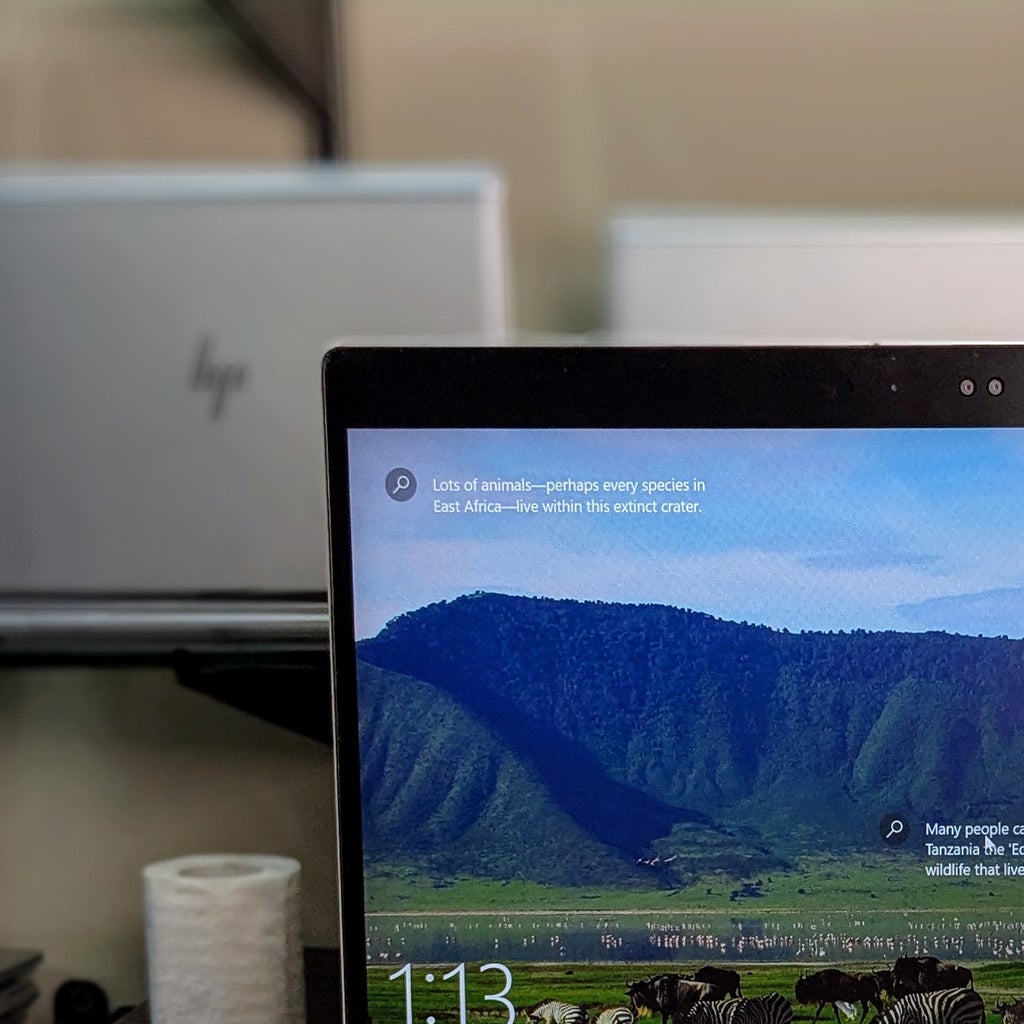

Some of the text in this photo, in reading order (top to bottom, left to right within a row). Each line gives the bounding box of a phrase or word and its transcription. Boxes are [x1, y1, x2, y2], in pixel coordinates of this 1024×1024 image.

[432, 477, 462, 493] Lots
[463, 477, 478, 493] of
[602, 479, 638, 495] every
[641, 477, 690, 495] species
[693, 477, 706, 492] in
[433, 499, 461, 514] East
[542, 498, 583, 514] within
[586, 498, 610, 513] this
[613, 498, 658, 514] extinct
[661, 499, 703, 514] crater.
[925, 823, 962, 839] Many
[965, 824, 1010, 839] people
[925, 842, 981, 857] Tanzania
[925, 862, 972, 877] wildlife
[974, 862, 1001, 877] that
